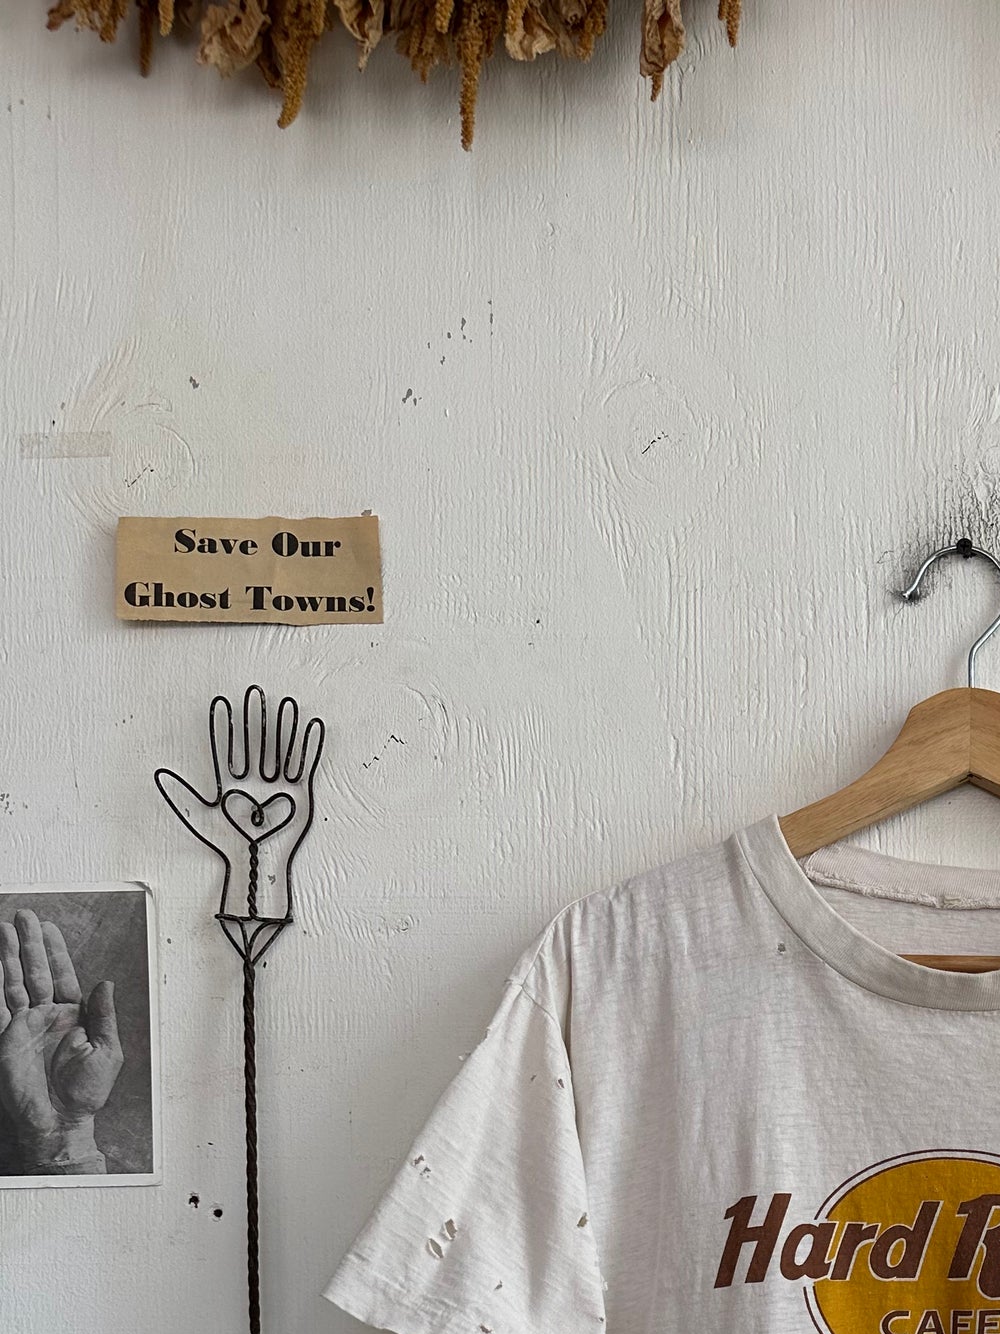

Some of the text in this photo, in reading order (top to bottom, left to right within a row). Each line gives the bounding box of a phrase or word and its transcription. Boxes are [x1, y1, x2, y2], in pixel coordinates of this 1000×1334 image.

[174, 528, 341, 557] Save Our
[124, 581, 375, 612] Ghost Towns!
[713, 1193, 941, 1288] Hard
